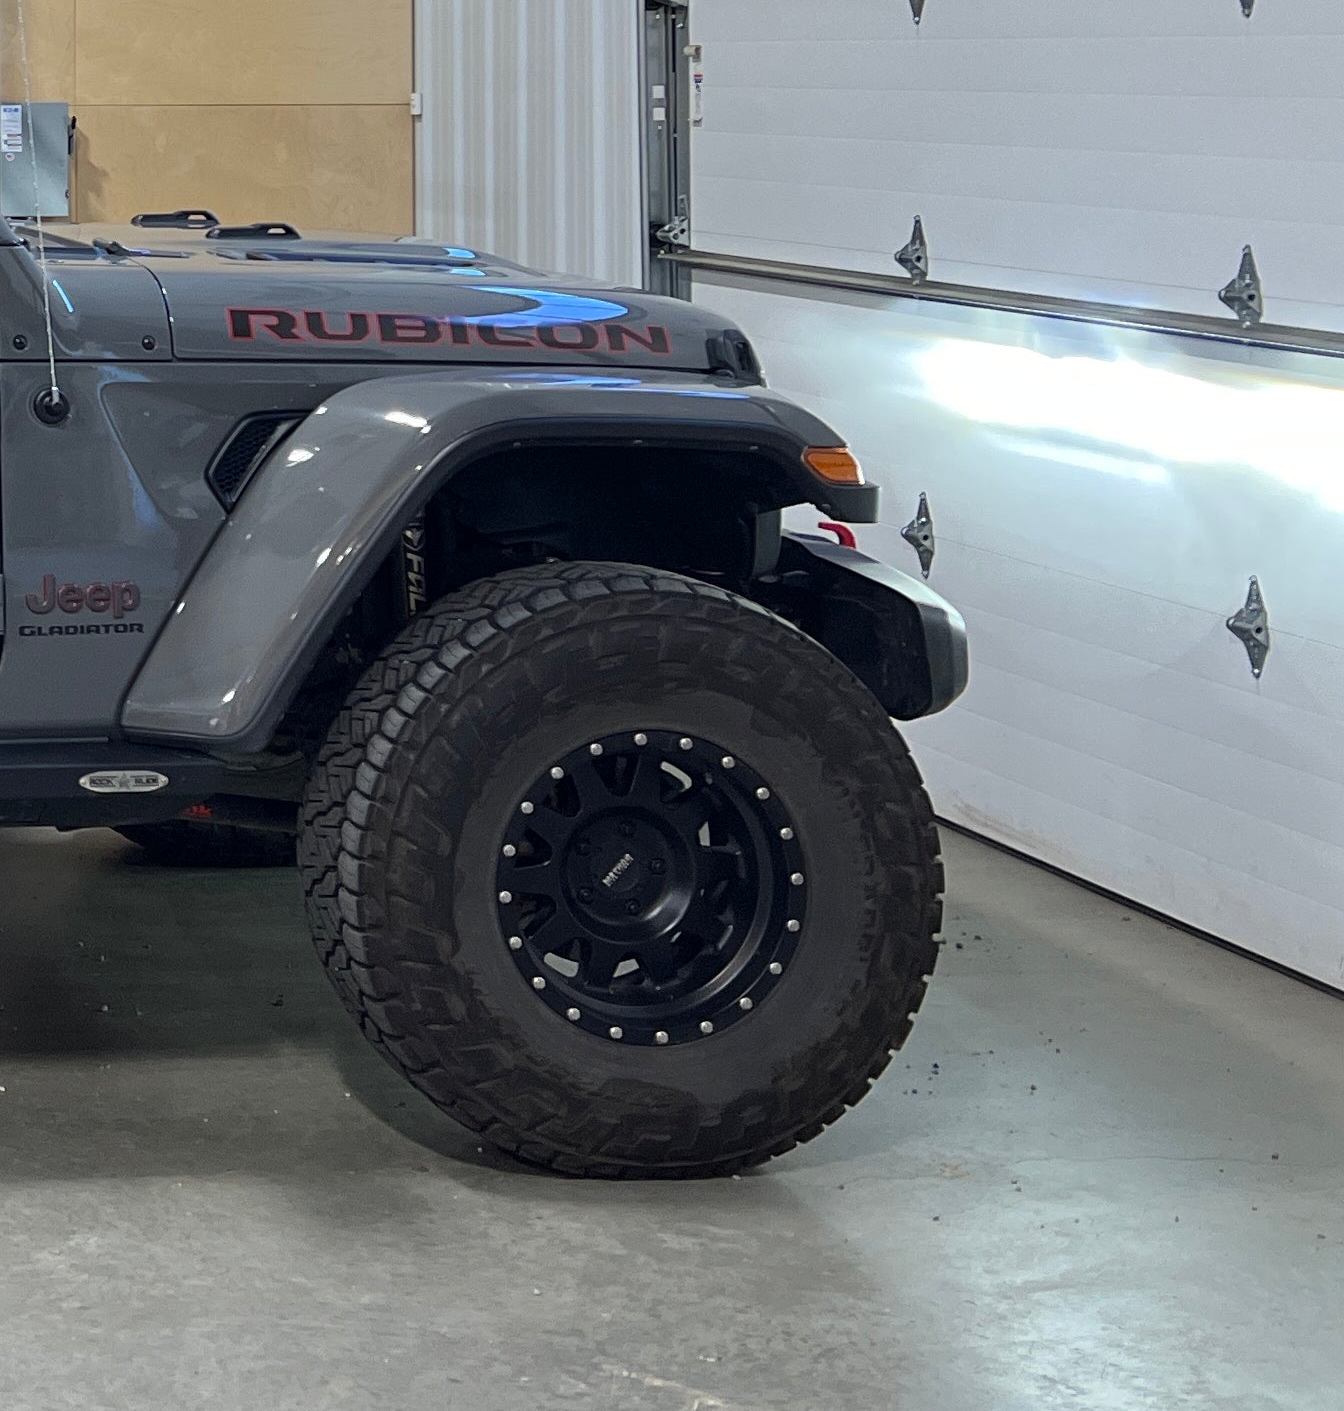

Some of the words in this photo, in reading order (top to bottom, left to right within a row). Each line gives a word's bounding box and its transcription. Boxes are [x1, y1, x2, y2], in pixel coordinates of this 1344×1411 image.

[226, 307, 673, 357] RUBICON
[25, 573, 141, 619] Jeep
[18, 622, 145, 637] GLADIATOR
